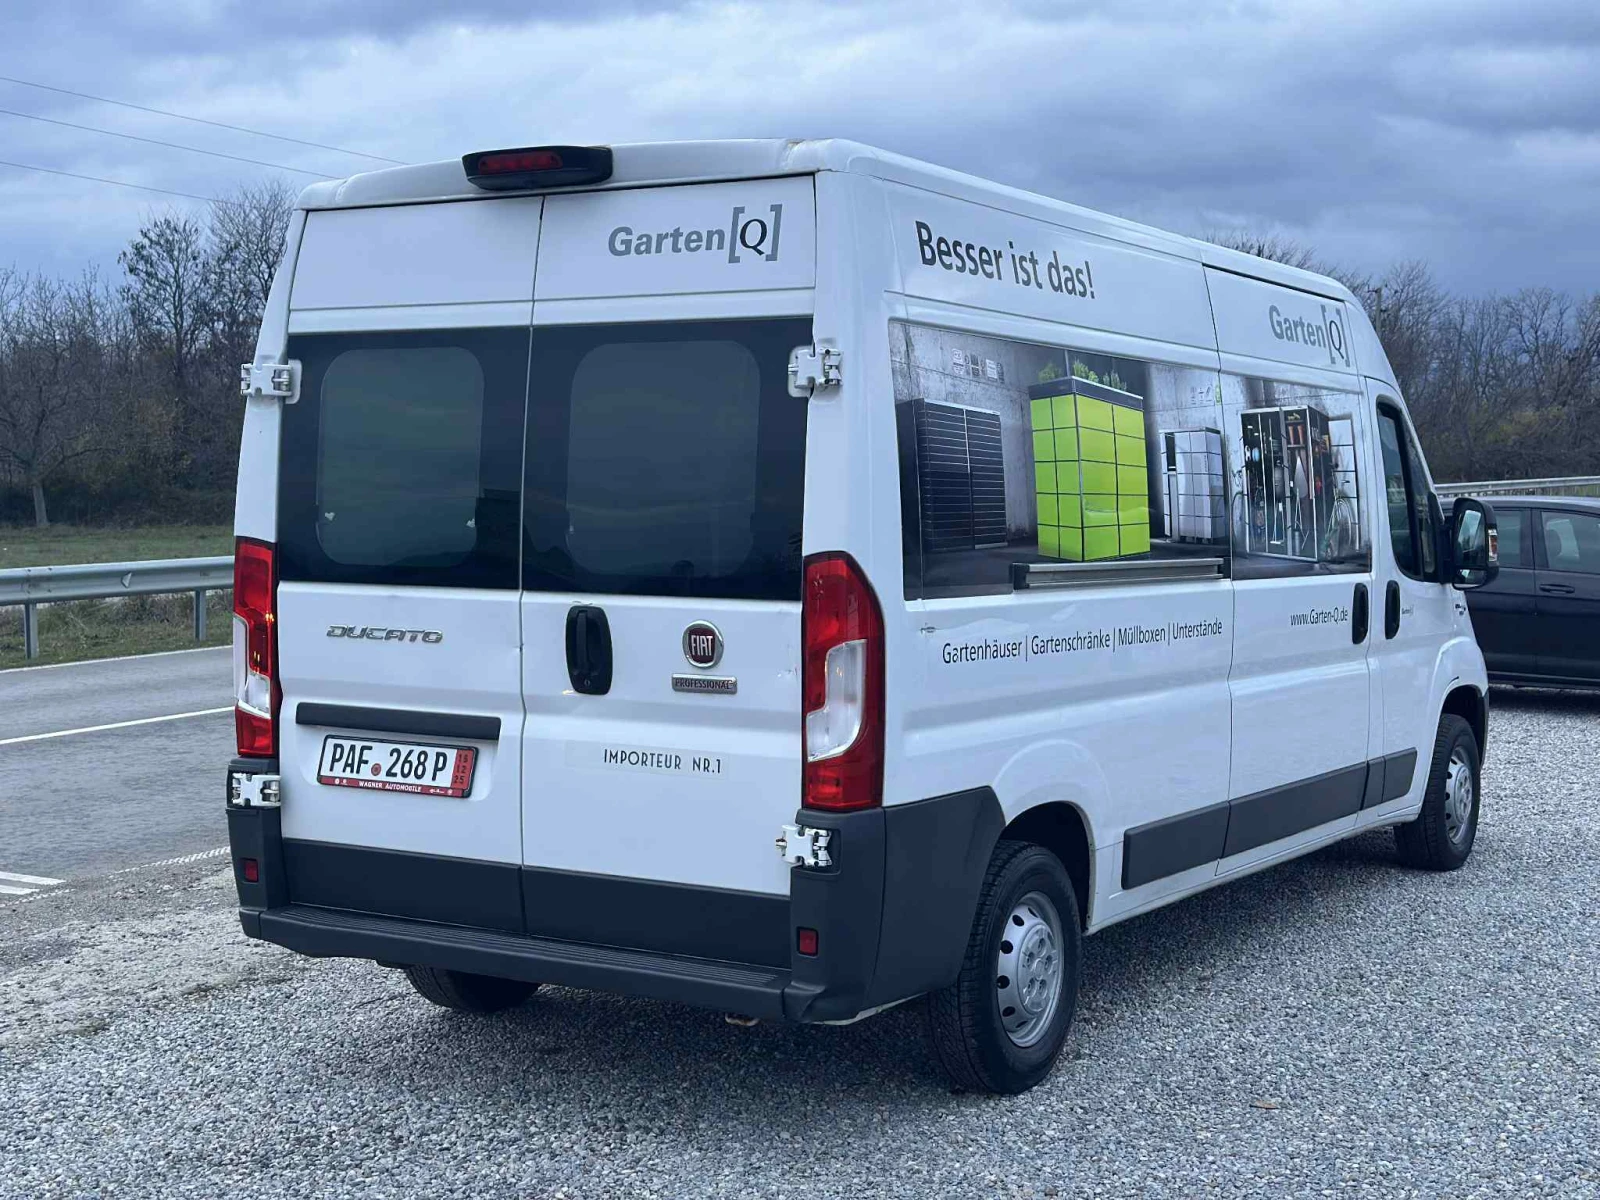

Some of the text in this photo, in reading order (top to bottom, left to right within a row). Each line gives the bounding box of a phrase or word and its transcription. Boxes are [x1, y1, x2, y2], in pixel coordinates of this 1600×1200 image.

[915, 220, 1096, 299] Besser ist das!
[1290, 606, 1348, 626] www.Garten-Q.de
[326, 624, 443, 644] DUCATO
[690, 634, 714, 656] FIAT
[942, 617, 1223, 664] Gartenhäuser Gartenschränke Müllboxen Unterstände
[674, 678, 734, 691] PROFESSIONAL
[329, 743, 448, 782] PAF 268 P
[603, 748, 721, 774] IMPORTEUR NR.1
[358, 780, 383, 789] WAGNER
[385, 783, 422, 793] AUTOMOBILE
